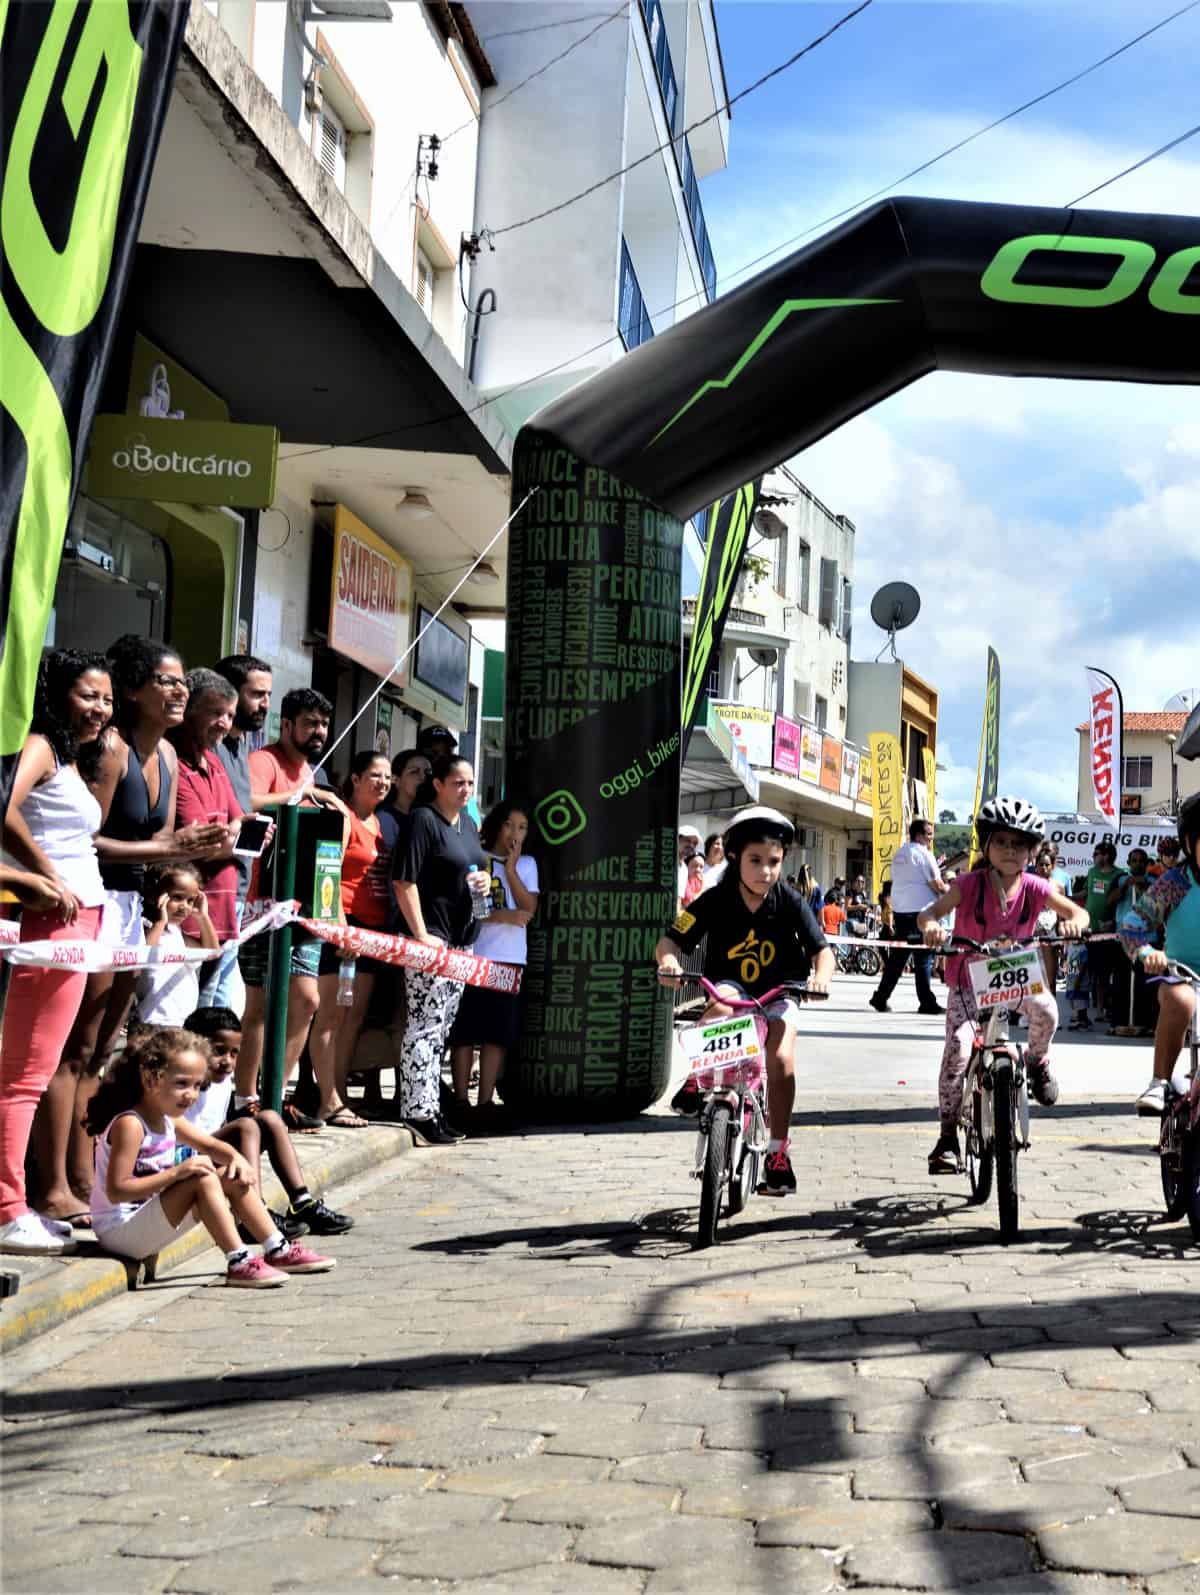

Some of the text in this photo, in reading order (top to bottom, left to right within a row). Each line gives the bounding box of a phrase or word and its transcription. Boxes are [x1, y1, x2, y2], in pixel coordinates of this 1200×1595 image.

[584, 500, 621, 525] BIKE
[528, 526, 600, 561] TRILHA
[520, 566, 545, 704] PERFORMANCE
[600, 733, 680, 799] oggi_bikes
[1051, 831, 1096, 844] OGGI
[1102, 833, 1132, 847] BIG
[551, 964, 577, 1005] FOCO
[989, 967, 1029, 989] 498
[980, 985, 1029, 1006] KENDA
[544, 1007, 583, 1033] BIKE
[583, 962, 625, 1099] SUPERAÇÃO
[703, 1032, 742, 1053] 481
[691, 1048, 744, 1069] KENDA
